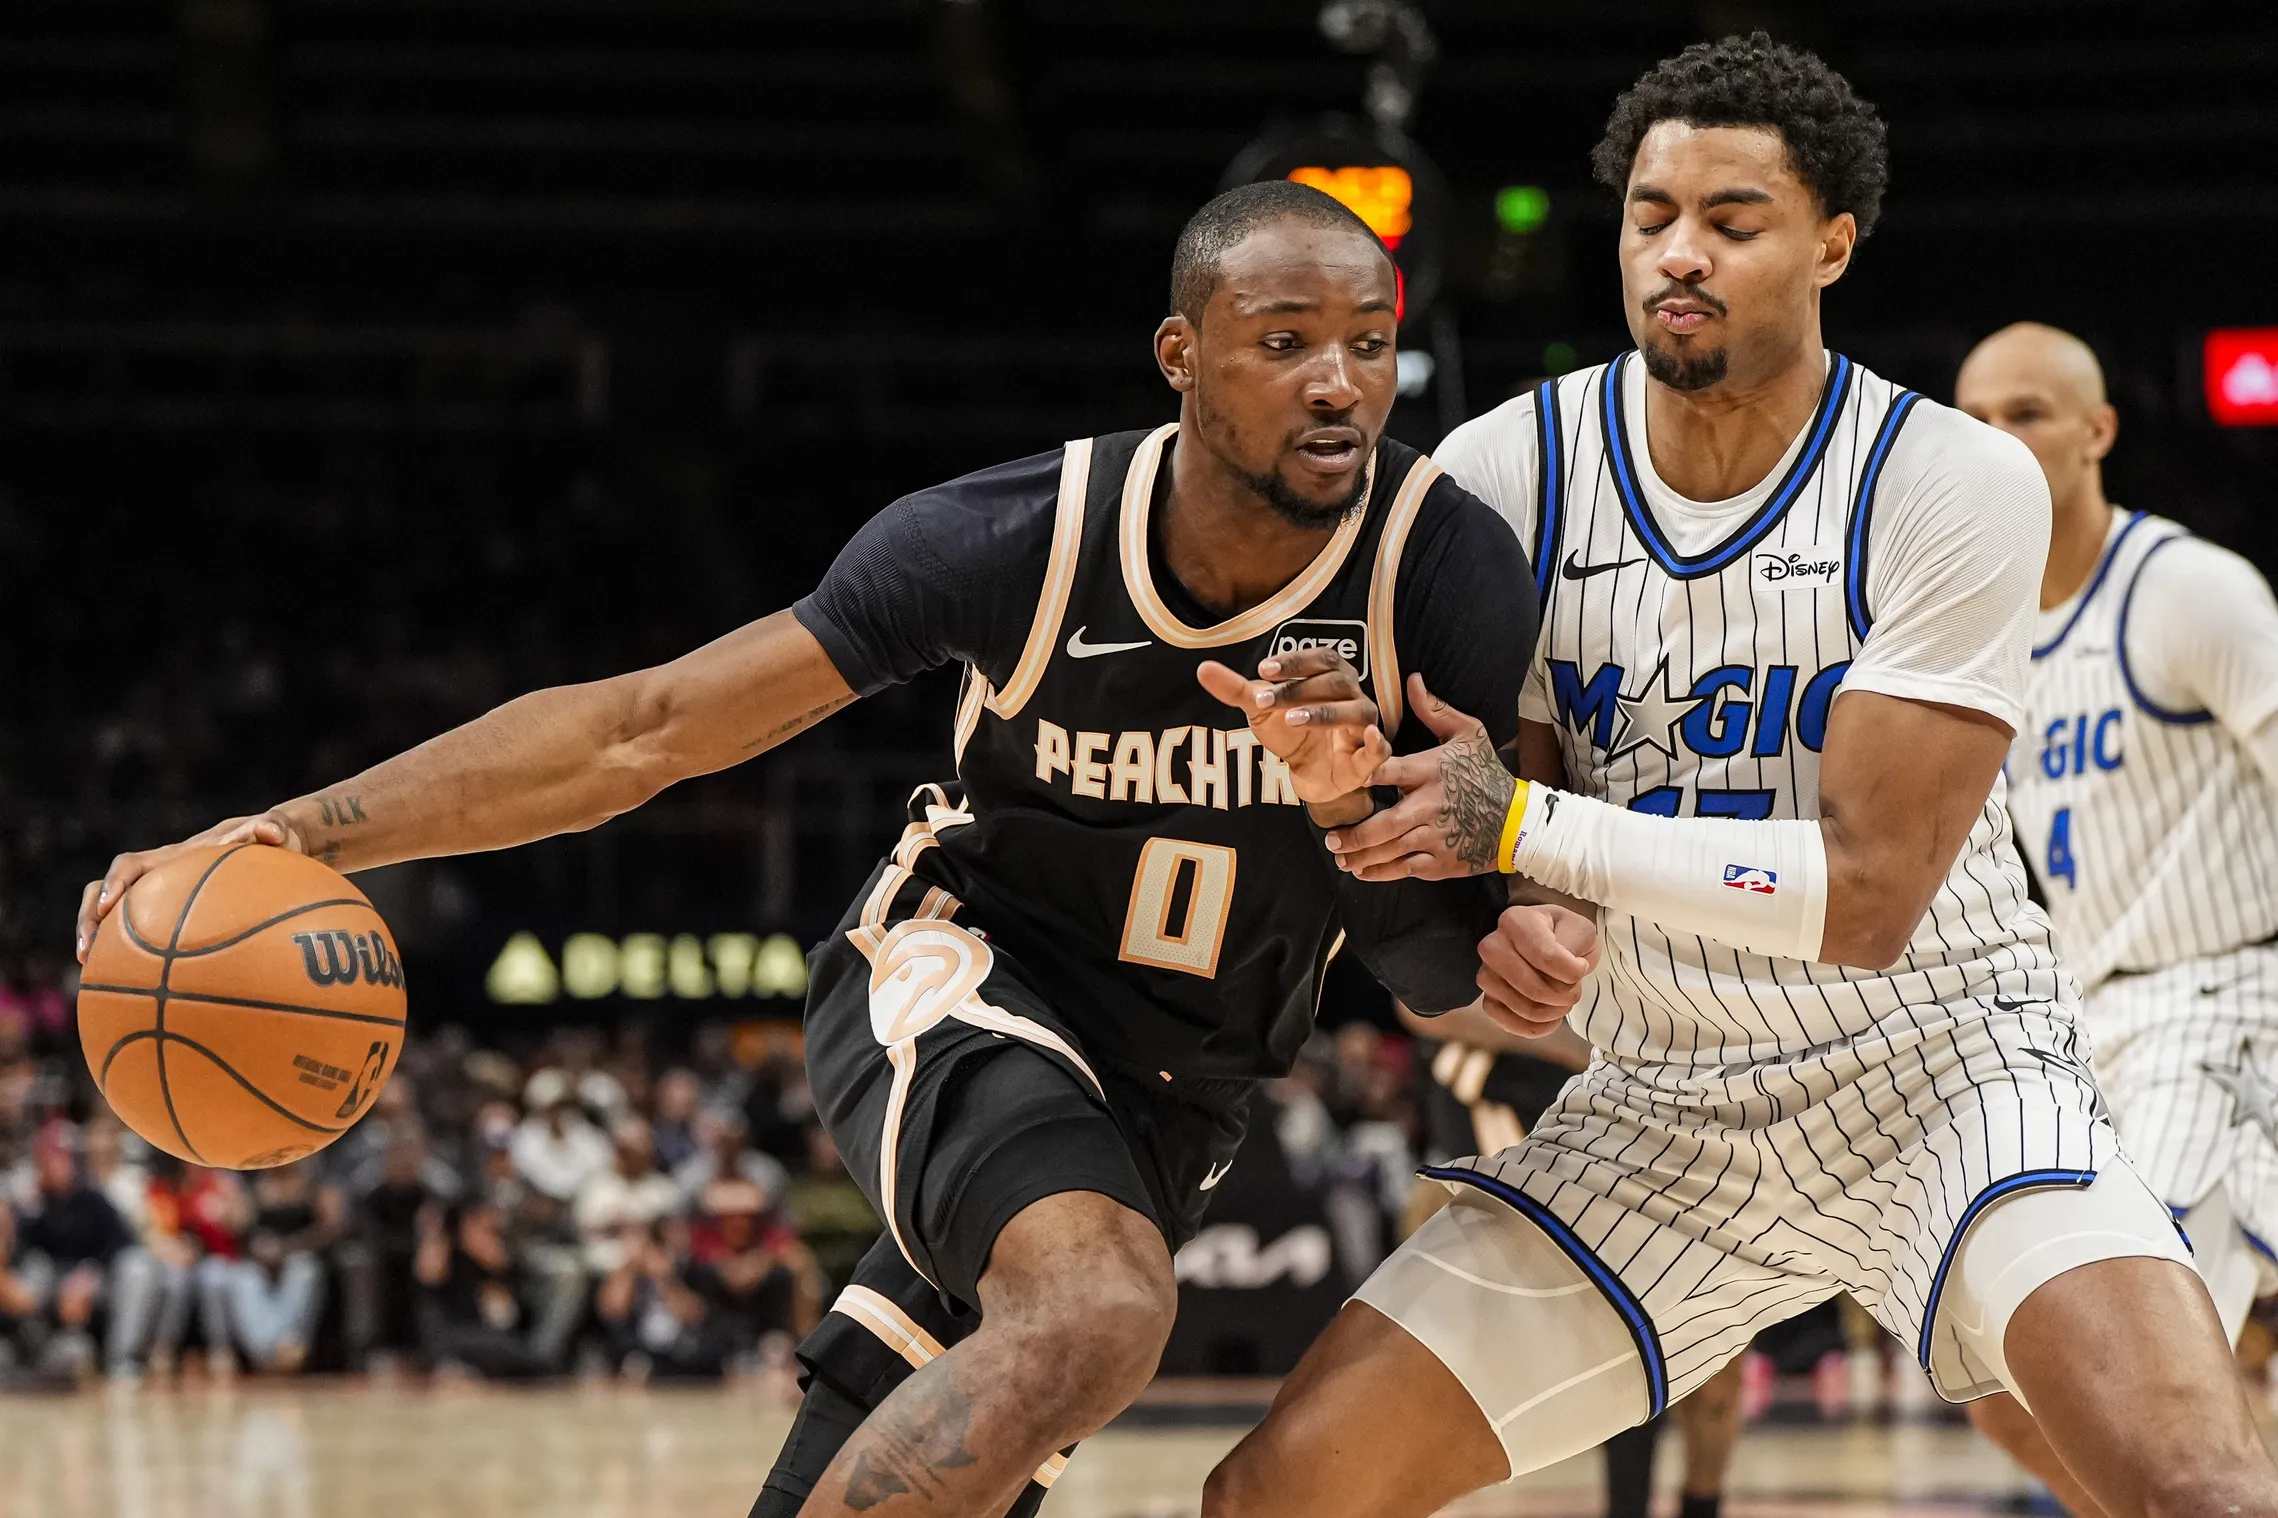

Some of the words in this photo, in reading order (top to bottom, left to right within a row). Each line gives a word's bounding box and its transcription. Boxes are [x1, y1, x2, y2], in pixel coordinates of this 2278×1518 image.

[1034, 718, 1302, 812] PEACHTR
[2047, 807, 2076, 889] 4
[1118, 837, 1237, 979] 0
[562, 932, 808, 999] DELTA
